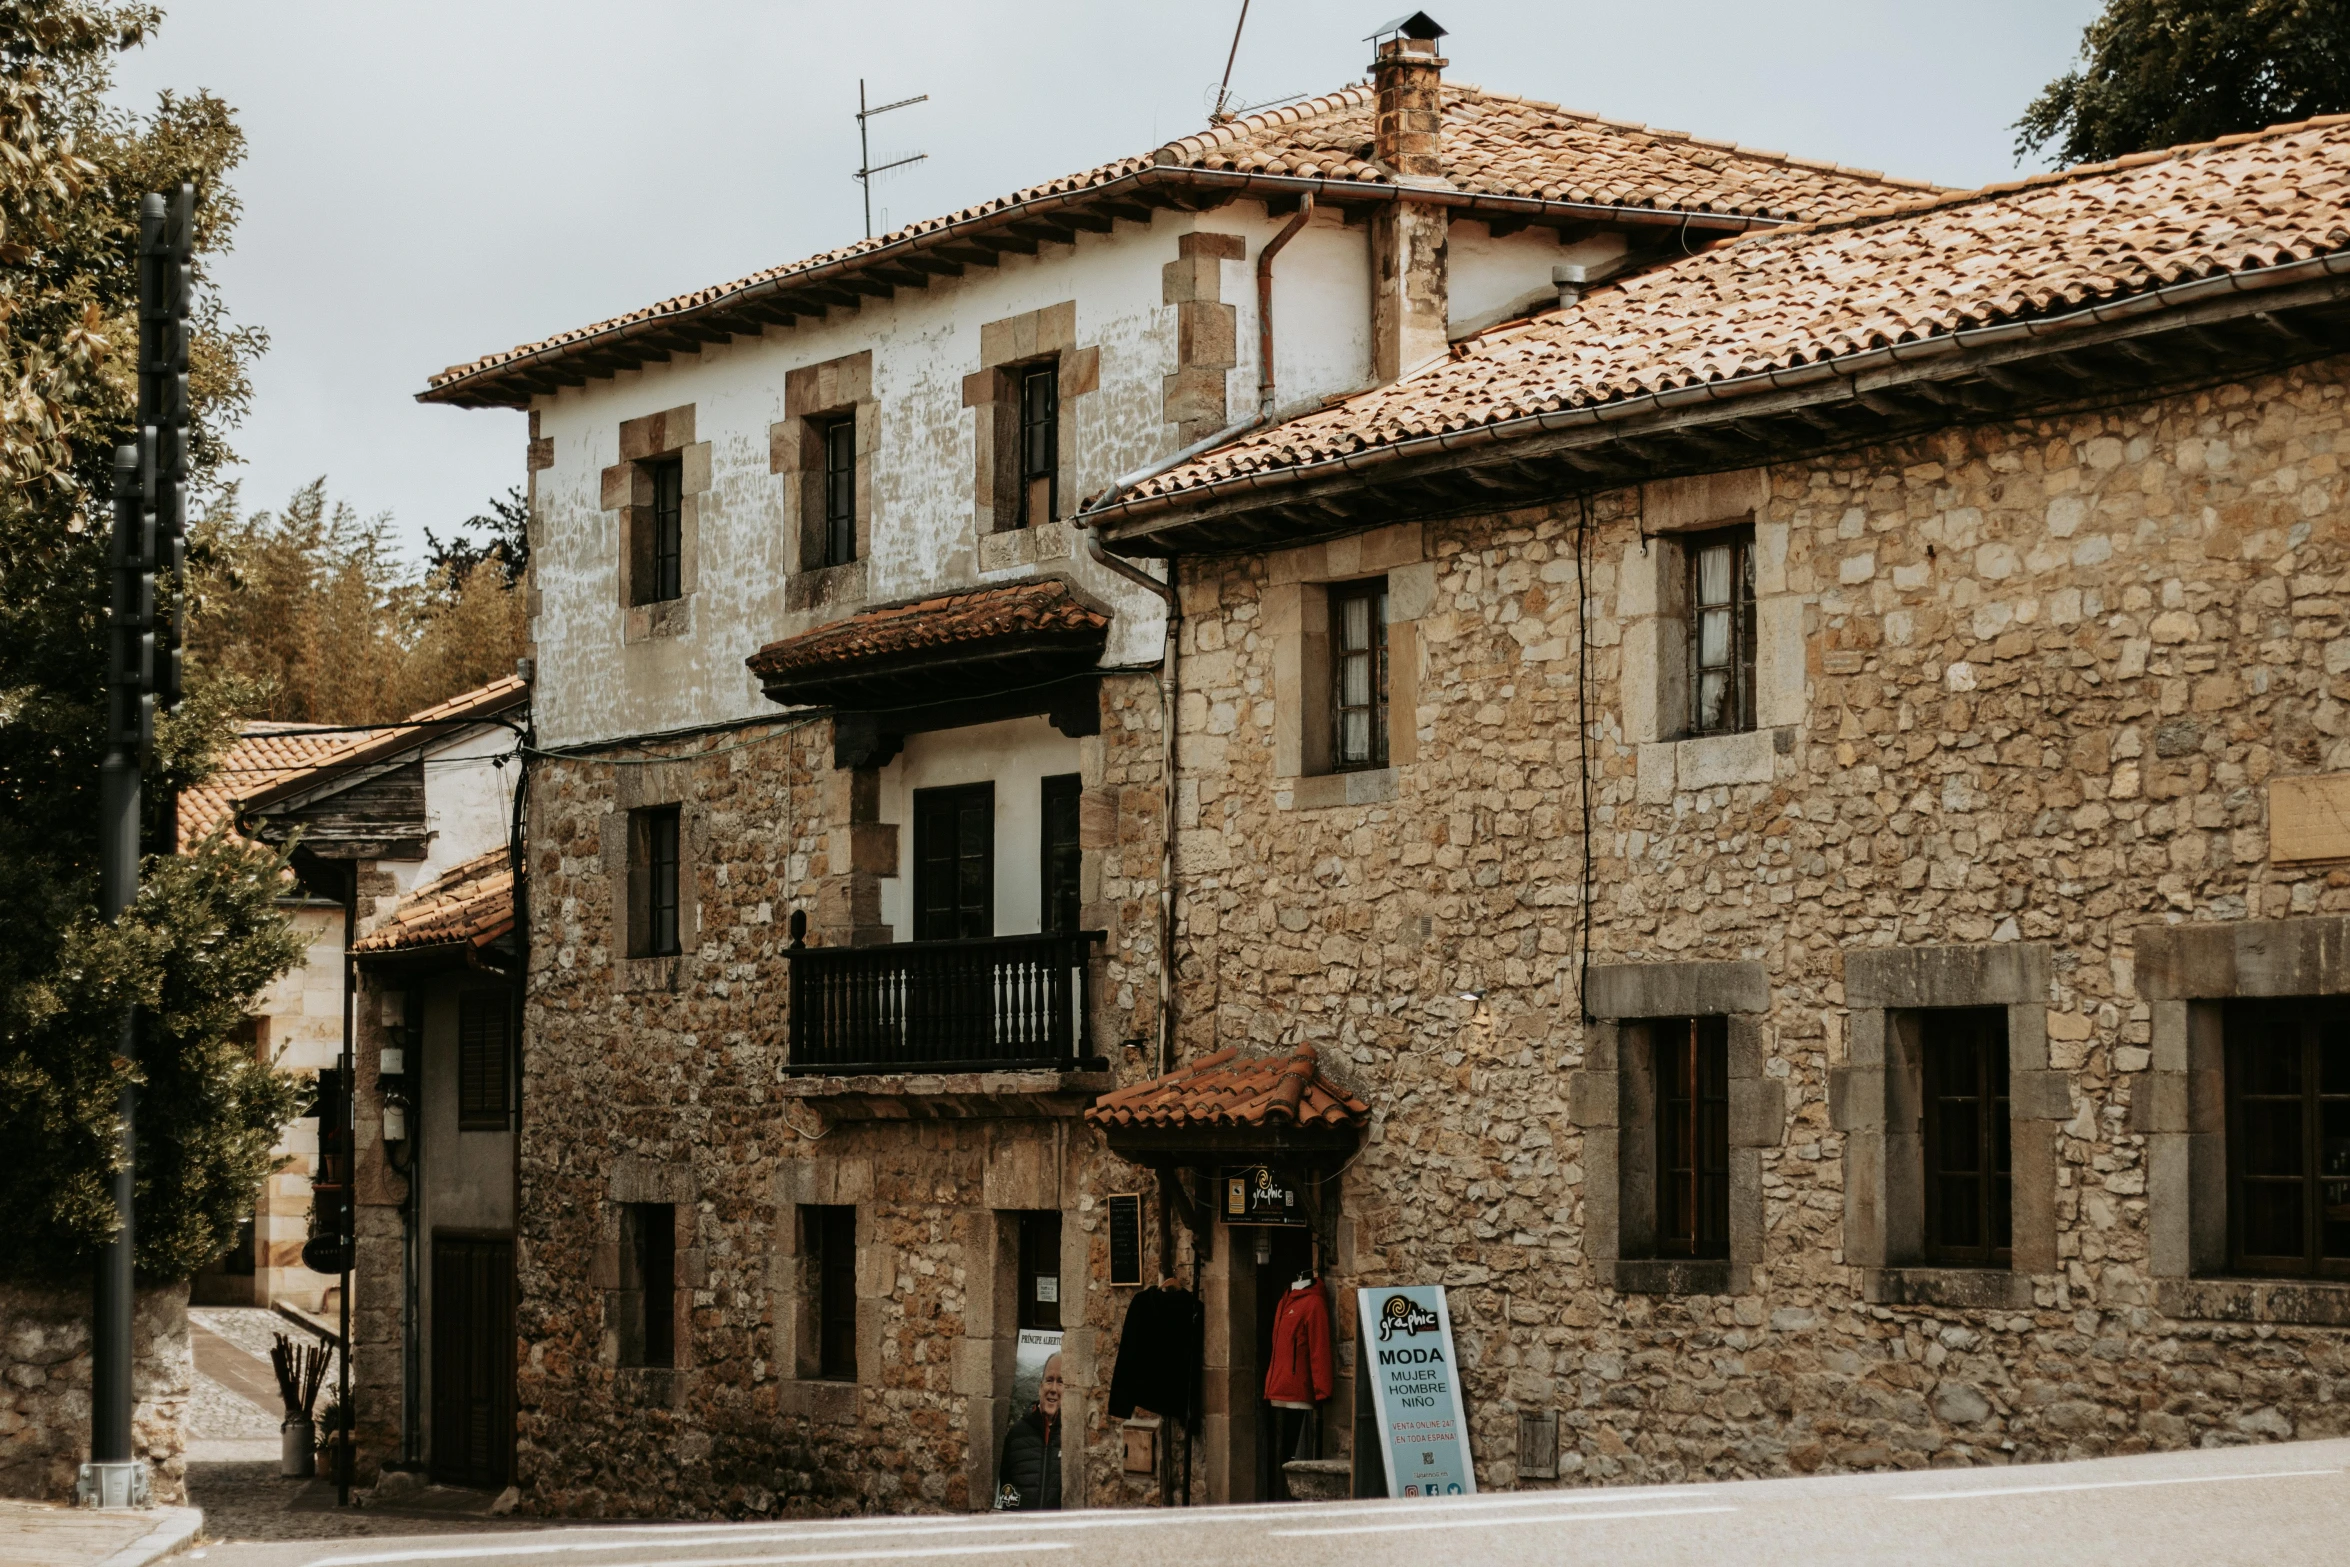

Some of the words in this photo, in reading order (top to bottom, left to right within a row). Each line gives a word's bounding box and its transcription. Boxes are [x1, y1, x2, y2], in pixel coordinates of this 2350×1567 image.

[1252, 1184, 1283, 1209] graphic
[1381, 1309, 1436, 1341] graphic
[1021, 1333, 1042, 1344] PRÍNCIPE
[1379, 1348, 1444, 1365] MODA
[1391, 1370, 1437, 1381] MUJER
[1389, 1383, 1447, 1395] HOMBRE
[1402, 1396, 1435, 1408] NIÑO
[1392, 1422, 1414, 1430] VENTA
[1416, 1420, 1440, 1429] ONLINE
[1442, 1420, 1455, 1428] 24/7
[1394, 1436, 1406, 1445] ¡EN
[1407, 1435, 1426, 1443] TODA
[1428, 1432, 1457, 1442] ESPAÑA!
